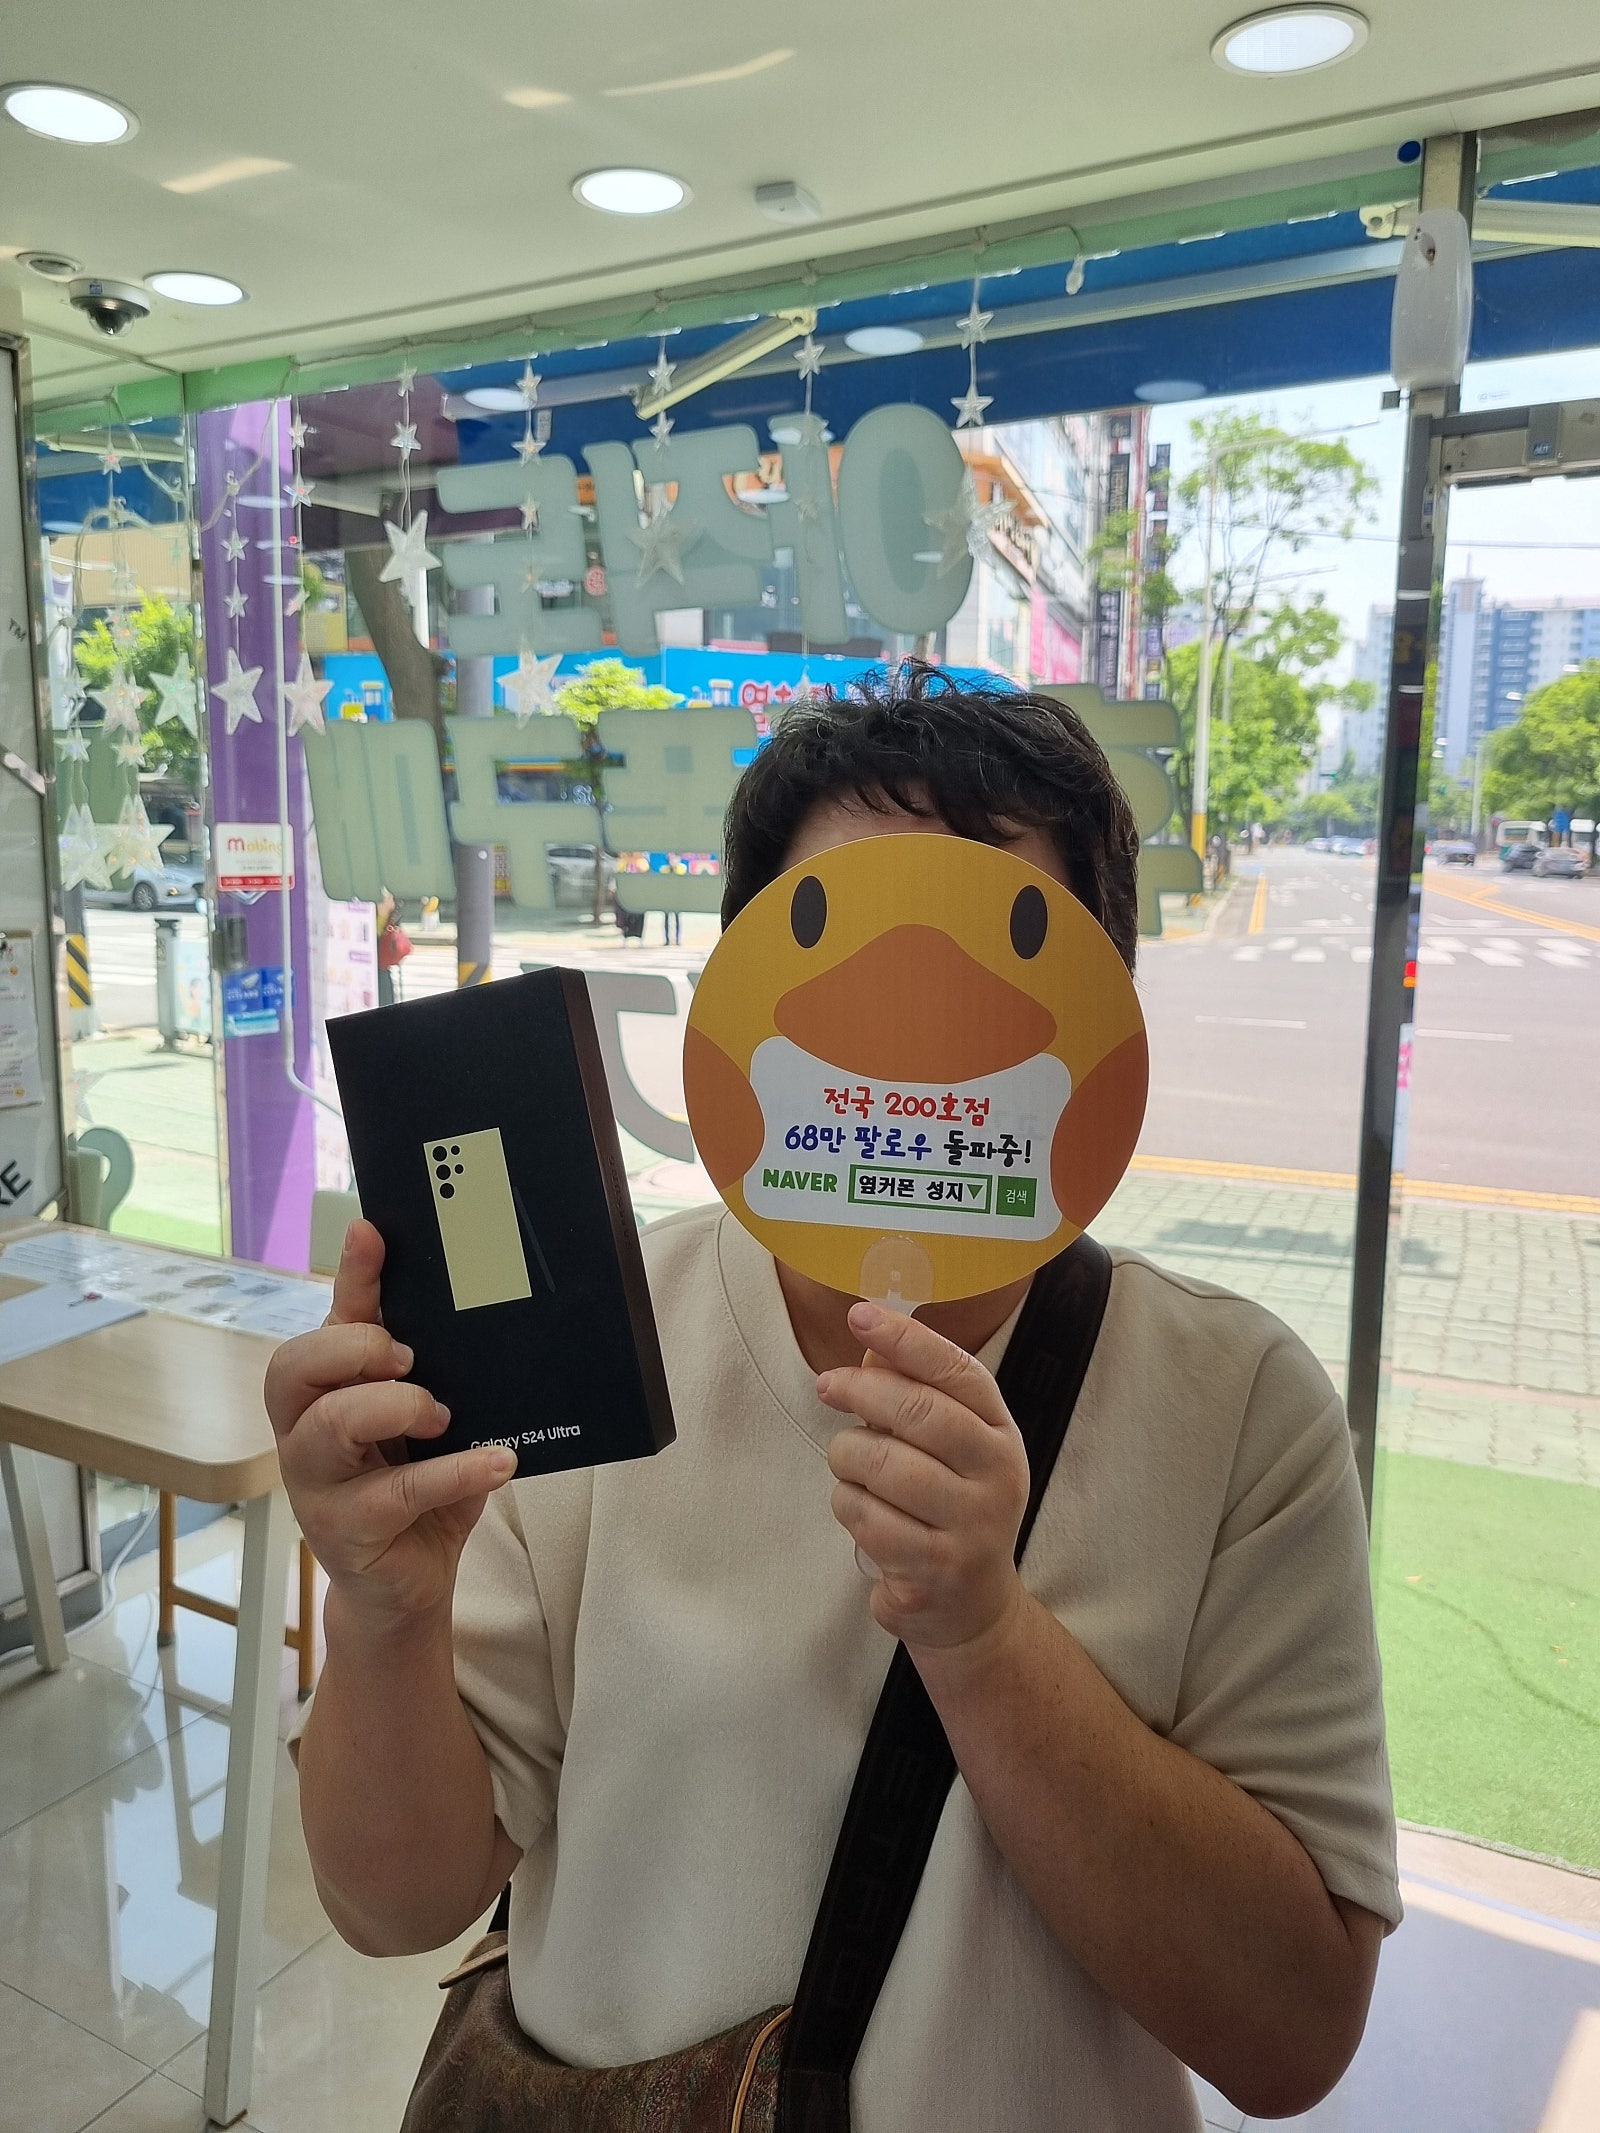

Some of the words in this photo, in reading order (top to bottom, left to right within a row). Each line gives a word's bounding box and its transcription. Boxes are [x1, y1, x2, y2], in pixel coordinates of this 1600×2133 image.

[823, 1085, 875, 1119] 전국
[884, 1091, 991, 1127] 200호점
[784, 1124, 847, 1154] 68만
[853, 1125, 933, 1161] 팔로우
[943, 1129, 1032, 1168] 돌파중!
[762, 1168, 839, 1194] NAVER
[858, 1175, 916, 1198] 옆커폰
[925, 1179, 965, 1203] 성지
[1005, 1188, 1028, 1206] 검색
[521, 1429, 546, 1445] S24
[546, 1424, 582, 1441] Ultra
